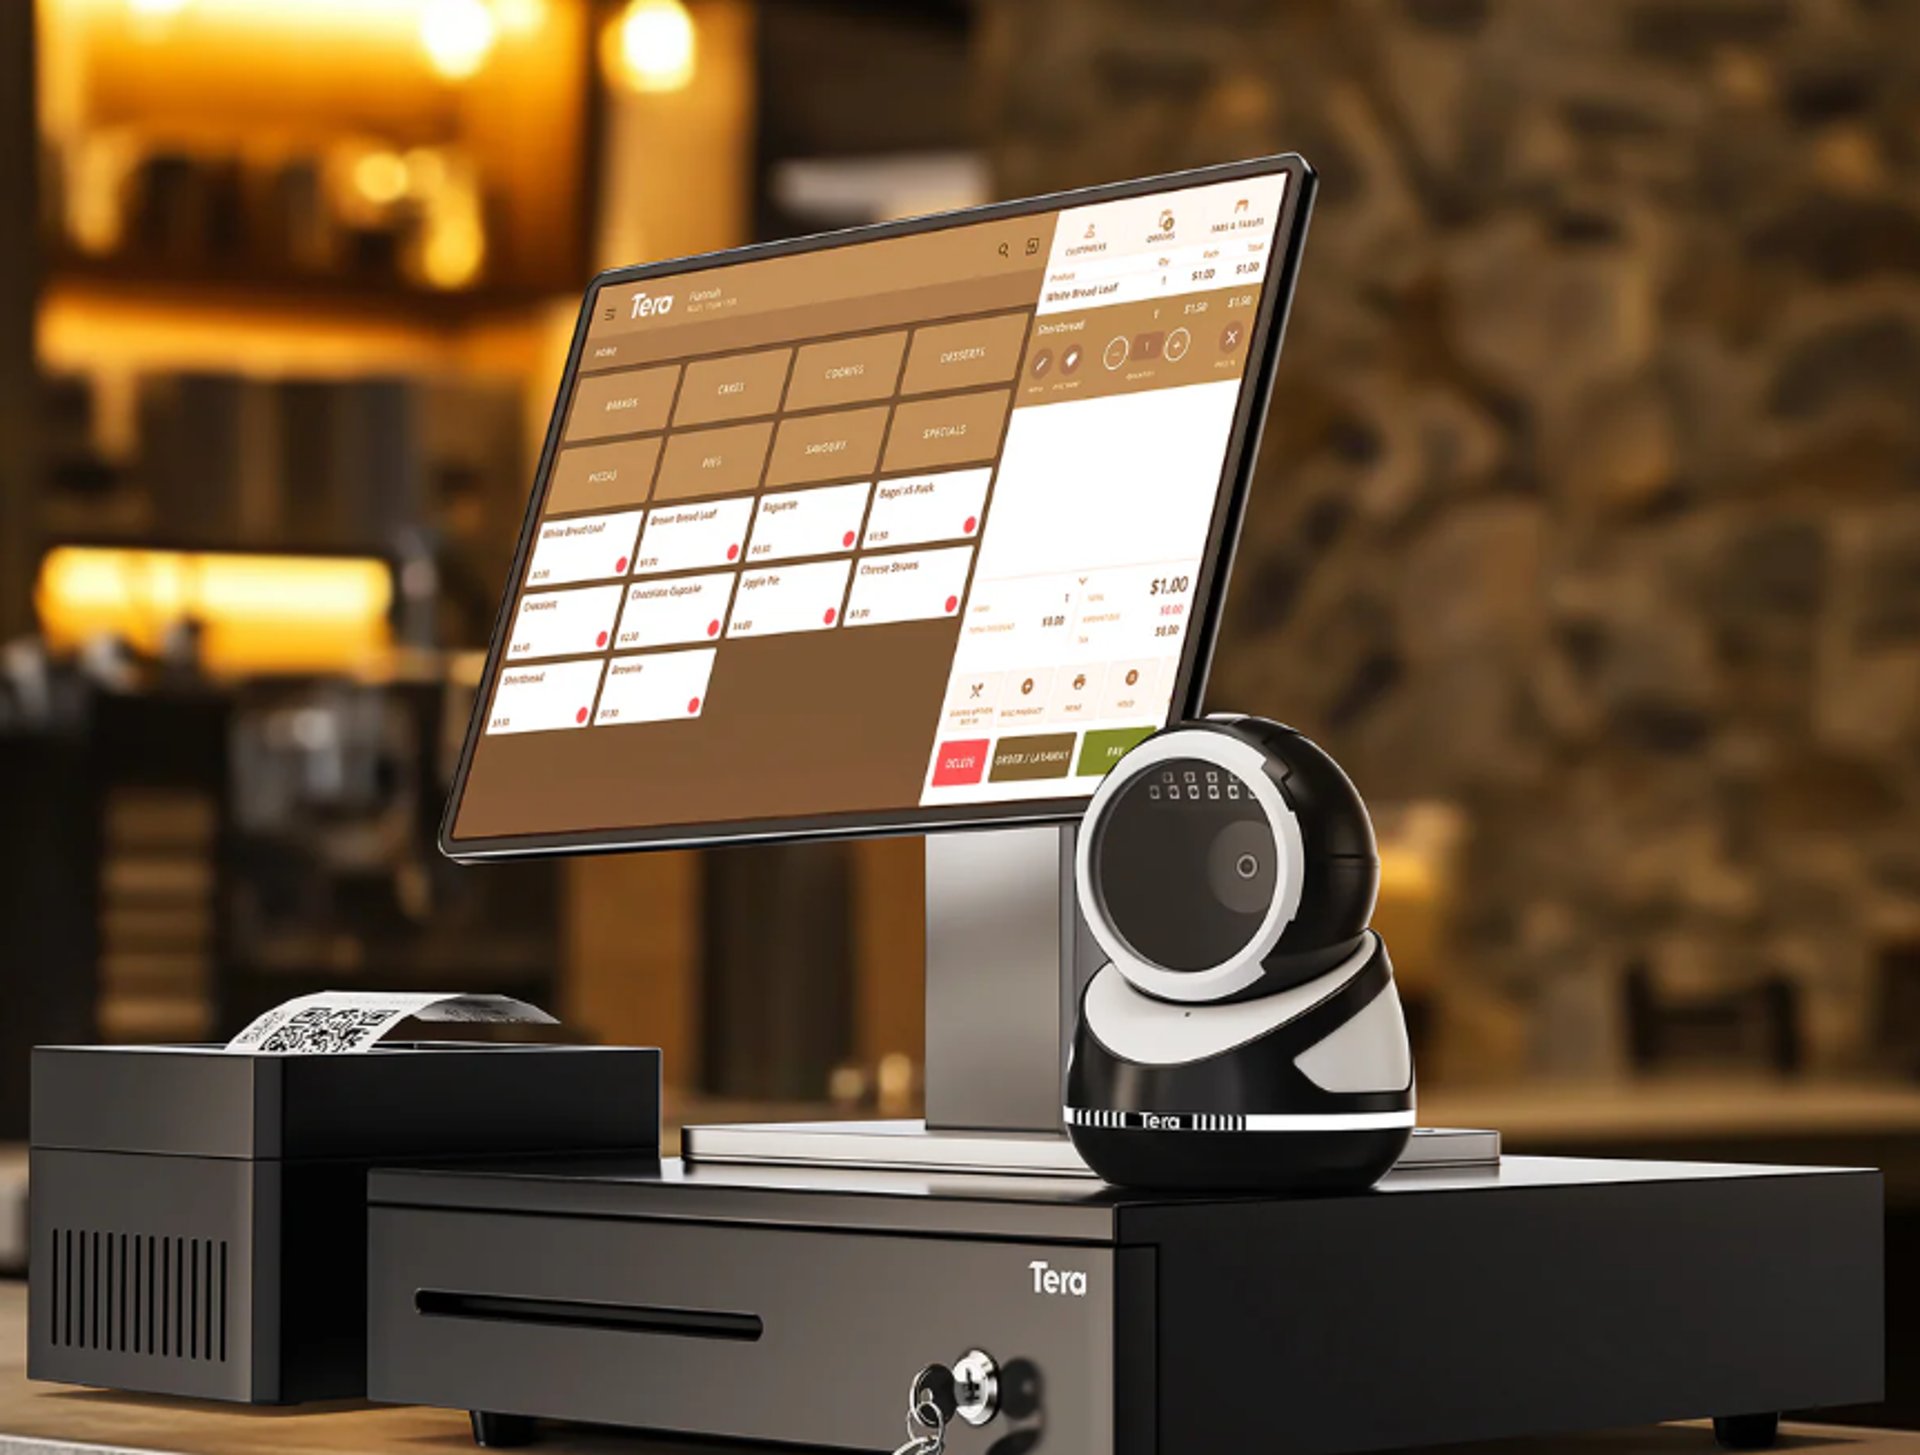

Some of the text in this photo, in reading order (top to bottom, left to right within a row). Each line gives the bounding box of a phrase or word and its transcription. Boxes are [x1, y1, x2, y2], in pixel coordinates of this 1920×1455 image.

[1046, 288, 1071, 303] White
[1072, 285, 1098, 300] Bread
[1191, 268, 1216, 282] $1.00
[1236, 261, 1260, 275] $1.00
[631, 292, 674, 319] Tera
[1037, 320, 1085, 336] Shortbread
[940, 346, 987, 363] DESSERTS
[825, 364, 864, 379] COOKIES
[718, 382, 744, 395] CAKES
[922, 424, 967, 439] SPECIALS
[879, 486, 901, 500] Bagel
[860, 564, 890, 577] Cheese
[1150, 575, 1189, 596] $1.00
[1106, 746, 1125, 758] PAY
[944, 757, 974, 770] DELETE
[1139, 1112, 1180, 1130] Tera
[1029, 1260, 1088, 1296] Tera
